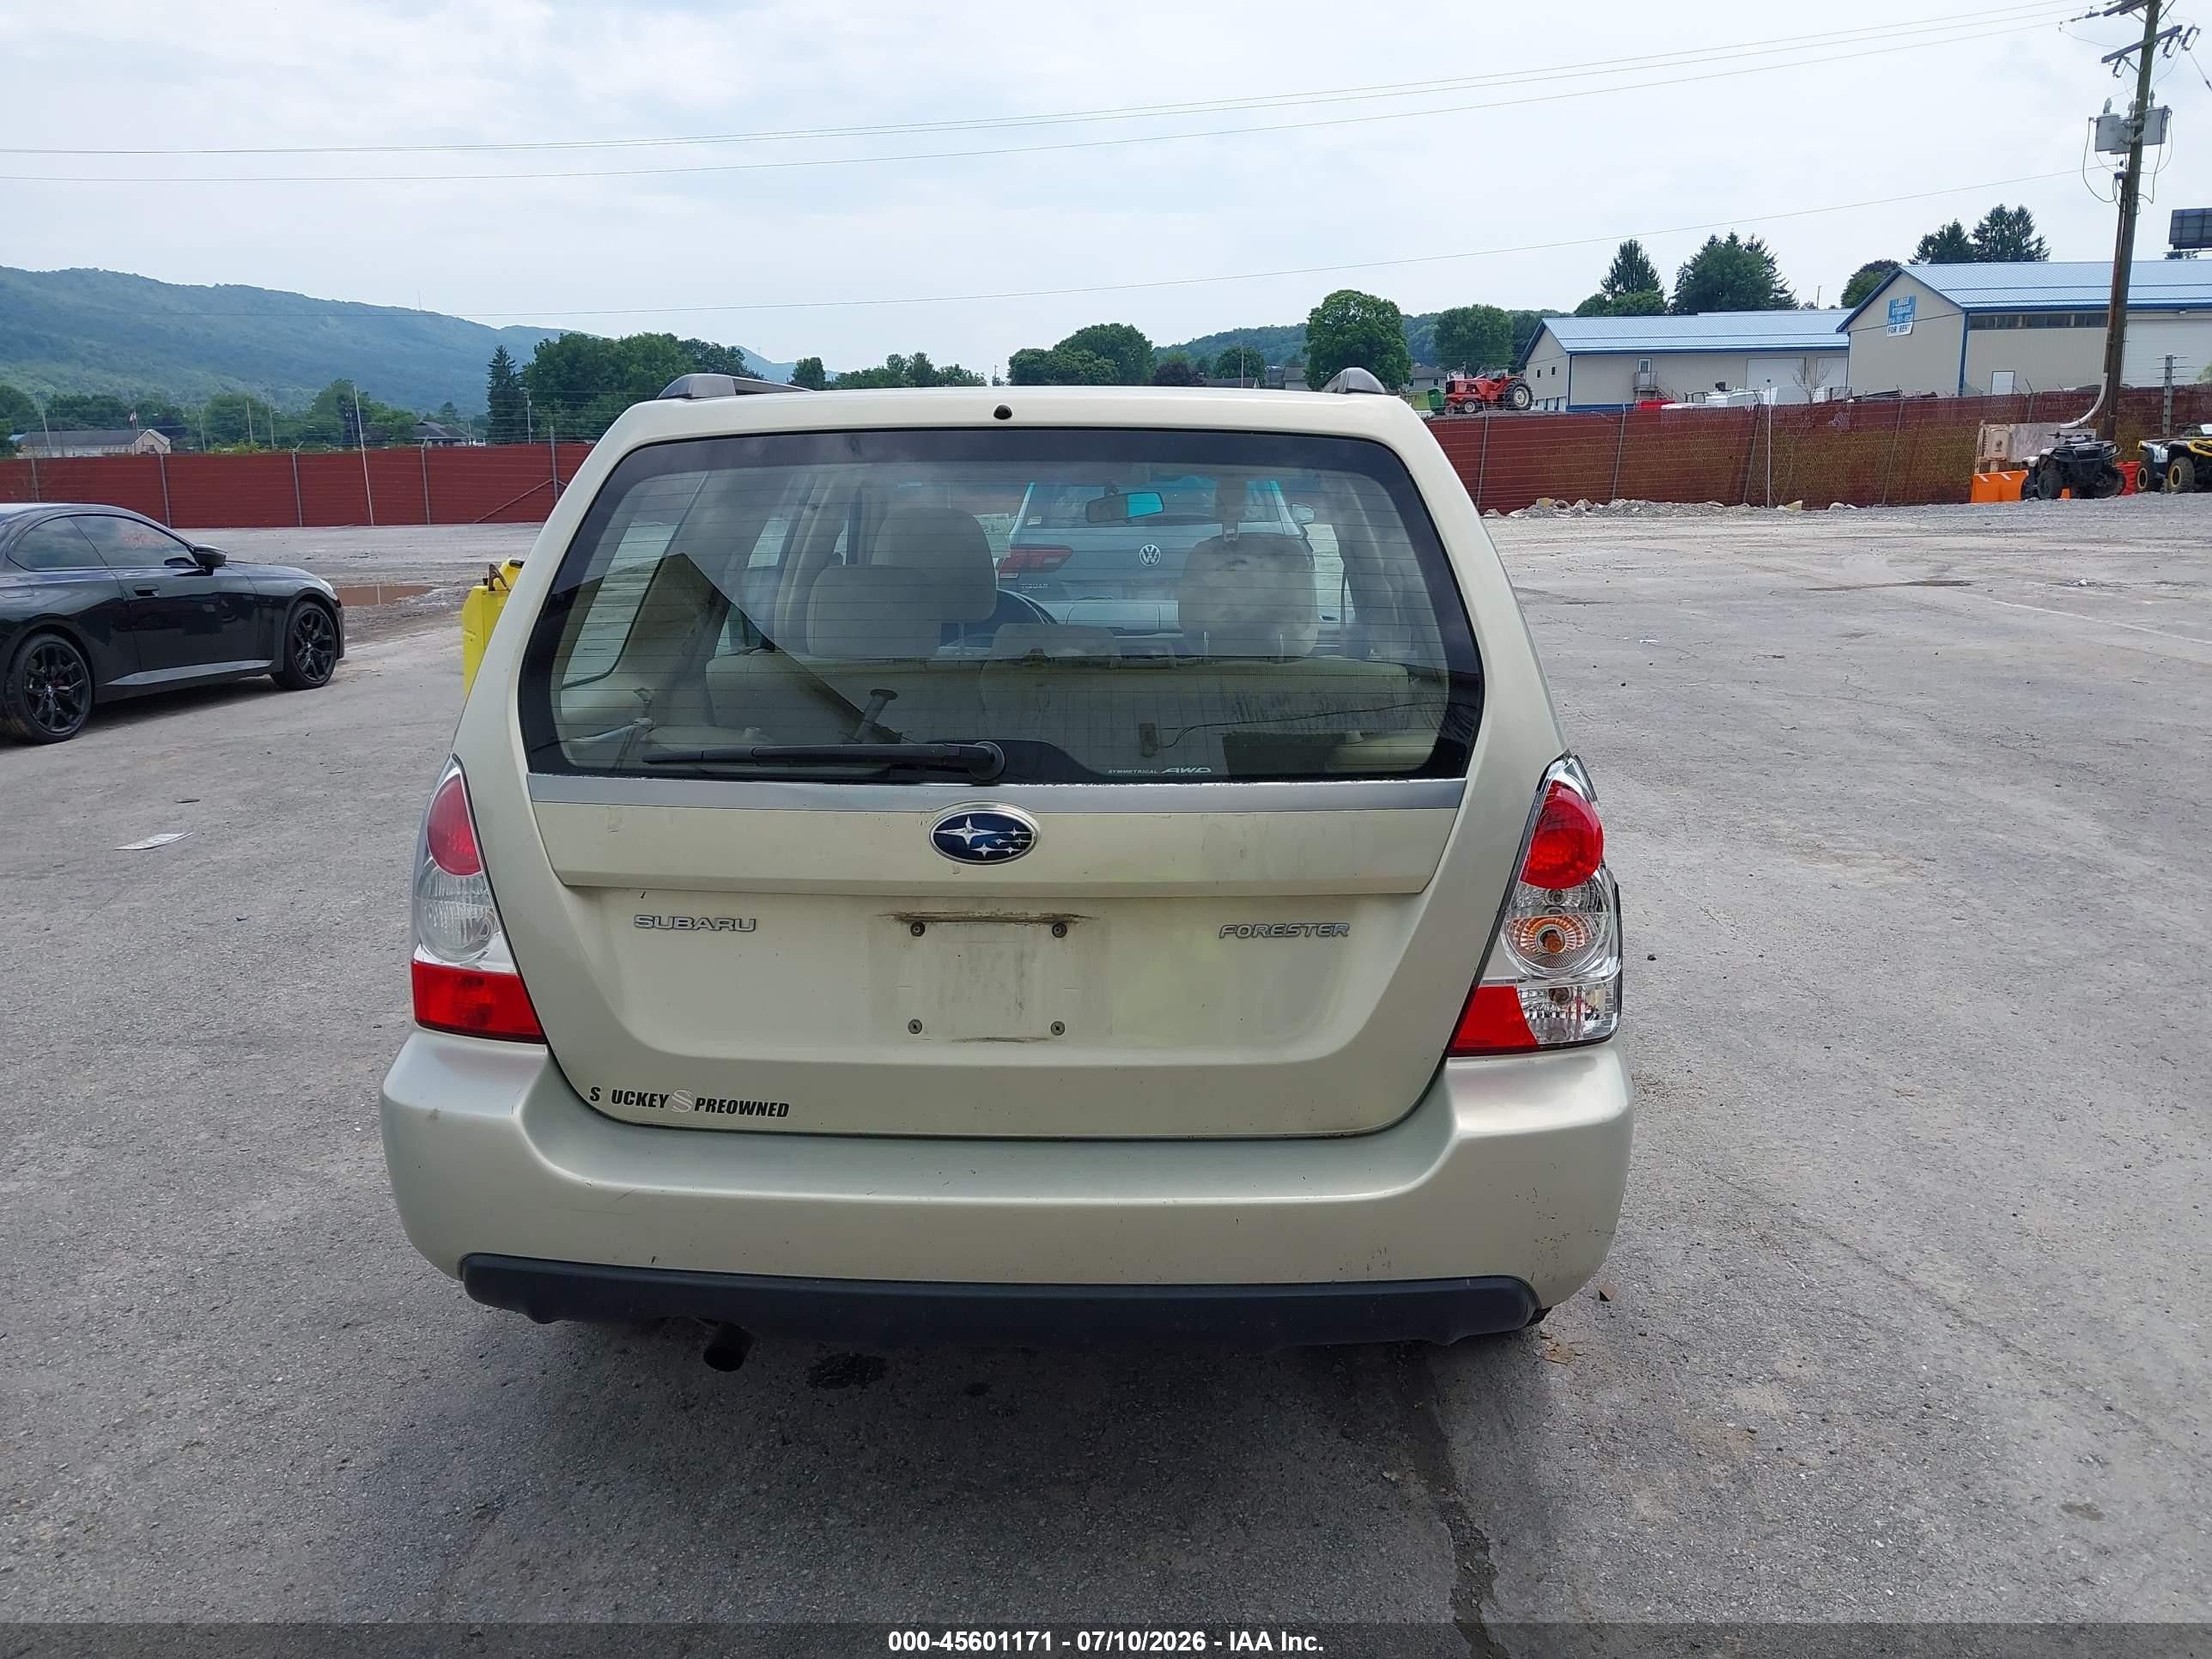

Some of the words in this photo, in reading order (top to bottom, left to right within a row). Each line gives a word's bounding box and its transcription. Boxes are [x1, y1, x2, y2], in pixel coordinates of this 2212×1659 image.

[1888, 325, 1898, 335] FOR
[1899, 324, 1911, 333] RENT
[634, 915, 757, 933] SUBARU
[1218, 923, 1350, 939] FORESTER
[694, 1097, 790, 1118] PREOWNED
